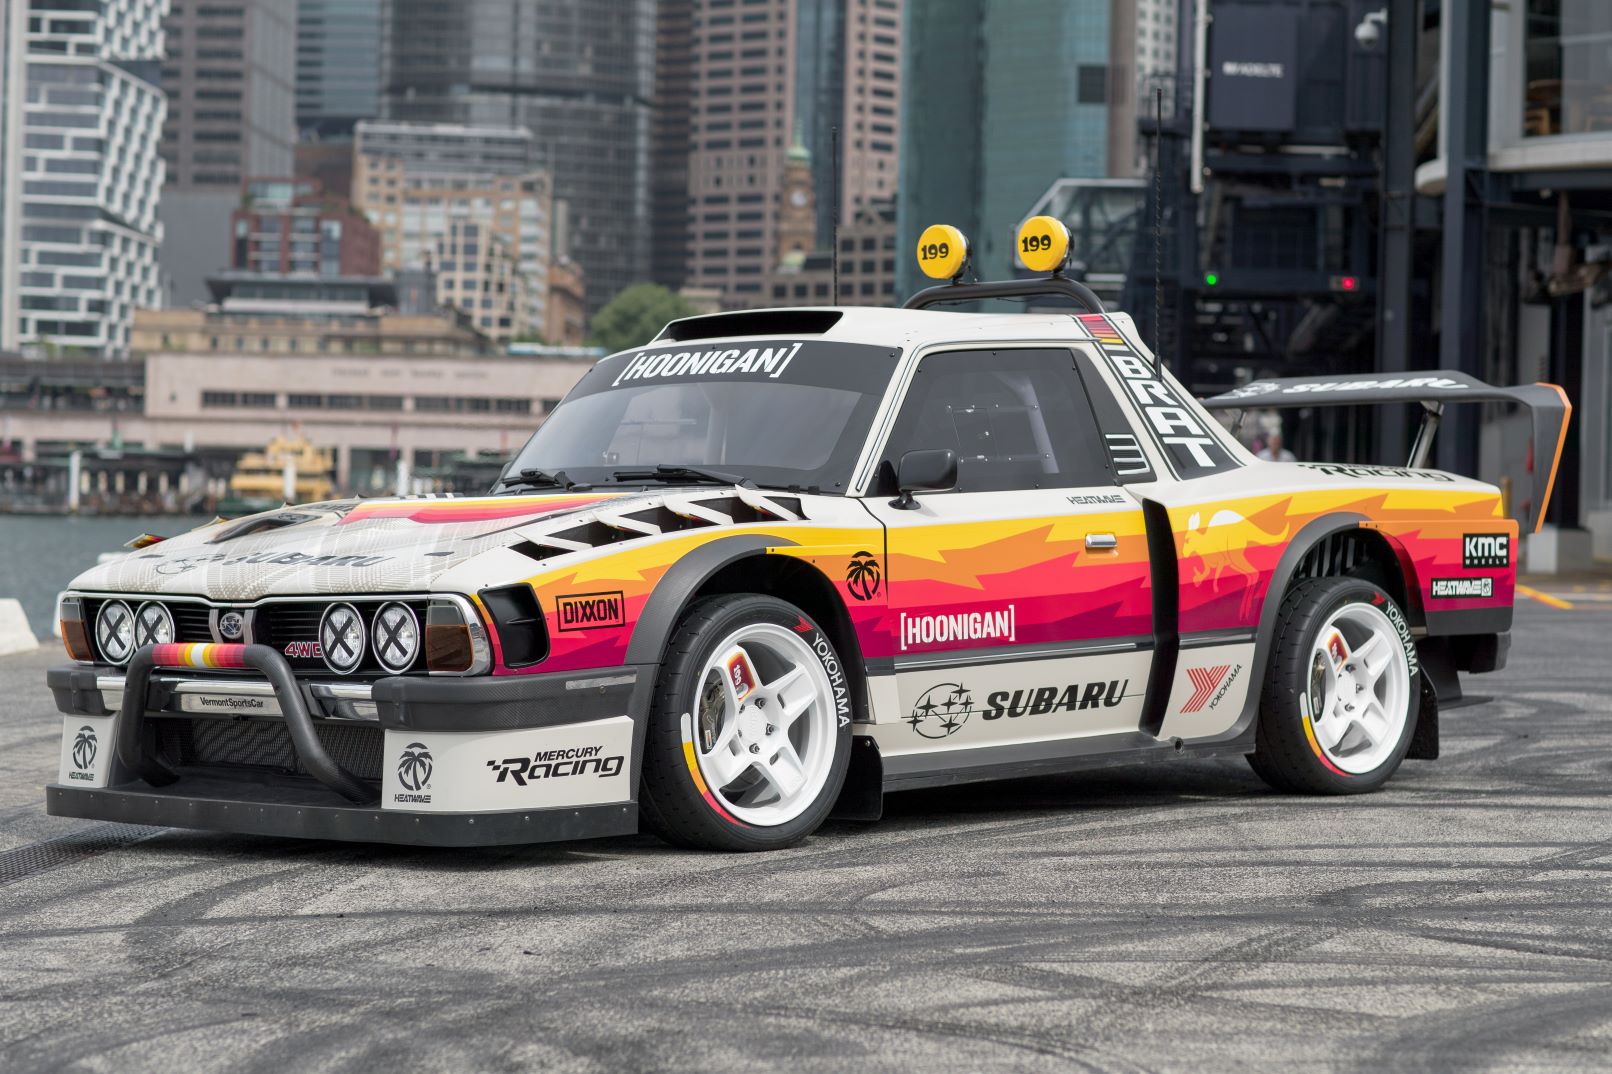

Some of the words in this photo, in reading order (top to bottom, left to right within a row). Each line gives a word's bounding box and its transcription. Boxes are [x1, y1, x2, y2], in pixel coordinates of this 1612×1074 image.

[922, 242, 949, 260] 199
[1022, 234, 1051, 252] 199
[1282, 377, 1470, 395] SUBARU
[1110, 355, 1217, 467] BRAT
[1066, 494, 1126, 505] HEATWAVE
[1432, 579, 1482, 596] HEATWAVE
[563, 597, 619, 624] DIXXON
[1386, 601, 1420, 677] YOKOHAMA
[812, 632, 850, 728] YOKOHAMA
[1208, 663, 1243, 711] YOKOHAMA
[201, 695, 265, 710] VermontSportsCar
[982, 679, 1129, 721] SUBARU
[534, 745, 604, 763] MERCURY
[69, 771, 95, 781] HEATWAVE
[496, 755, 624, 787] Racing
[394, 793, 432, 804] HEATWAVE
